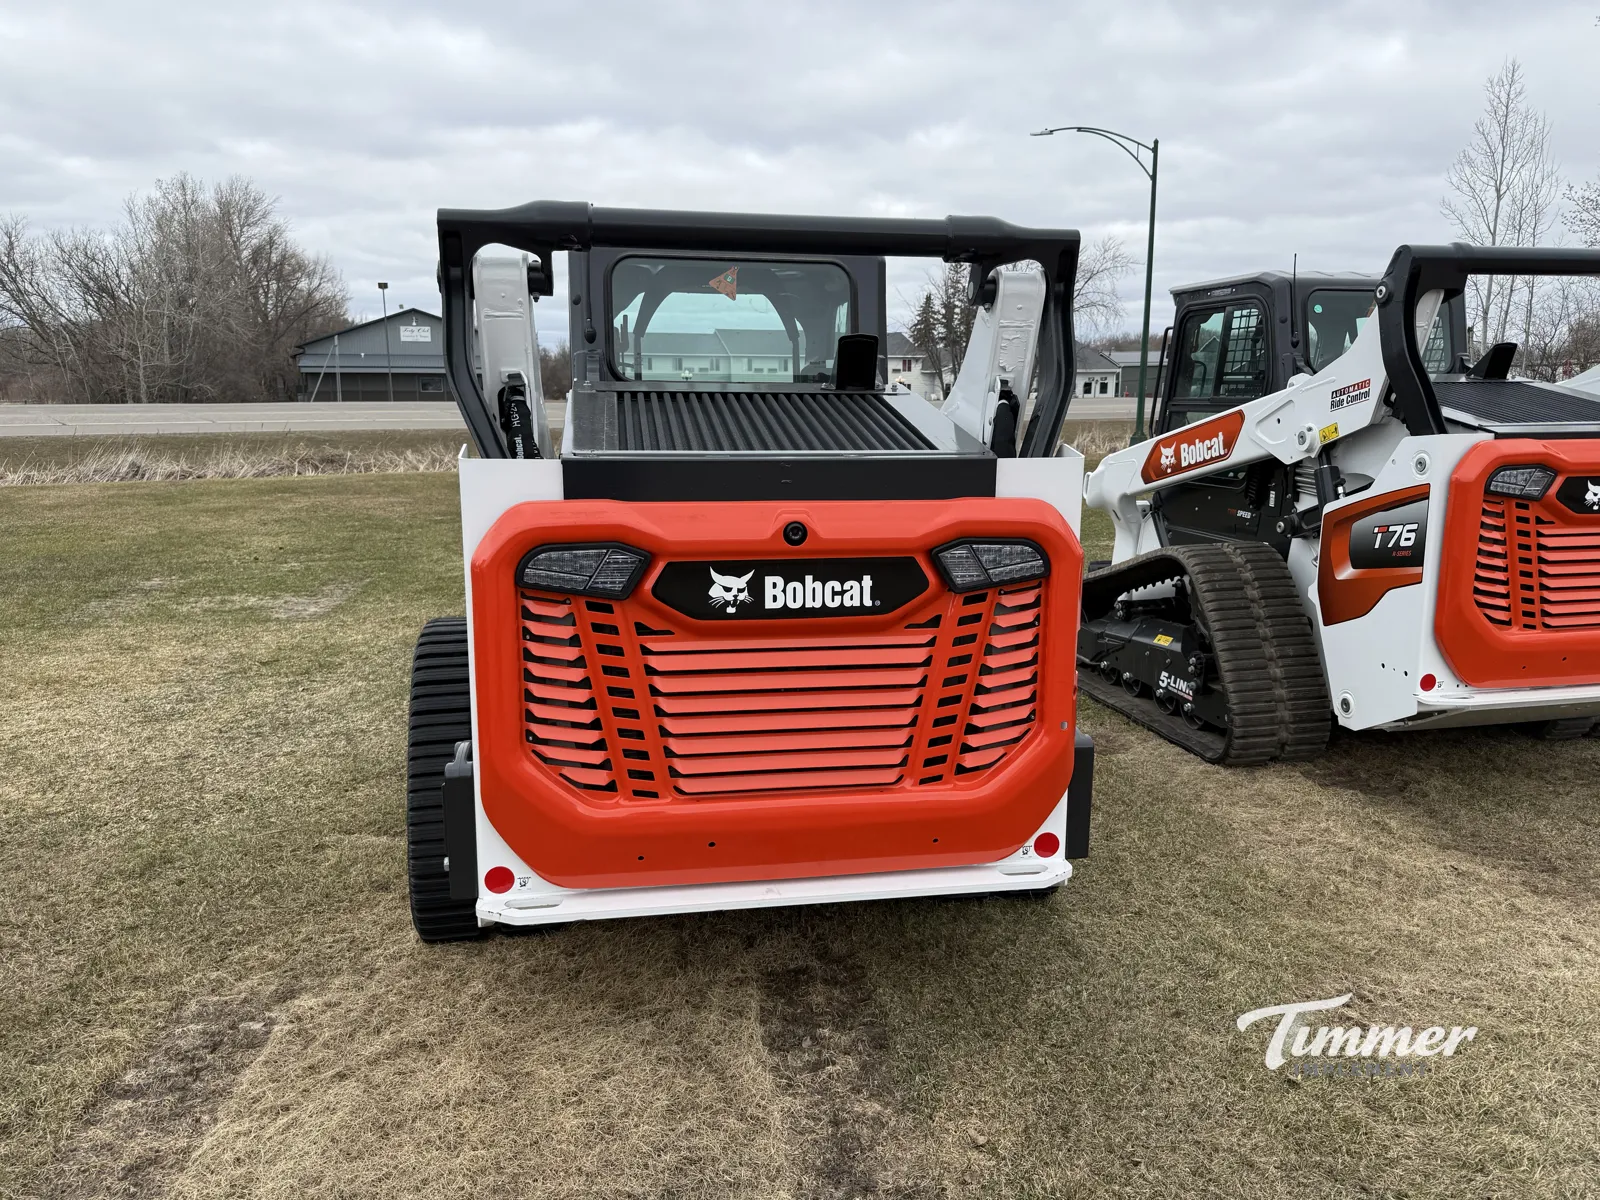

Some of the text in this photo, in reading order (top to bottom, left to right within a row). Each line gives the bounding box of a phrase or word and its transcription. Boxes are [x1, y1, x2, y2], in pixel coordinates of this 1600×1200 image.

[1330, 387, 1371, 410] Ride Control
[1332, 380, 1370, 399] AUTOMATIC
[1180, 431, 1225, 468] Bobcat
[1373, 523, 1419, 549] T76
[764, 574, 873, 609] Bobcat
